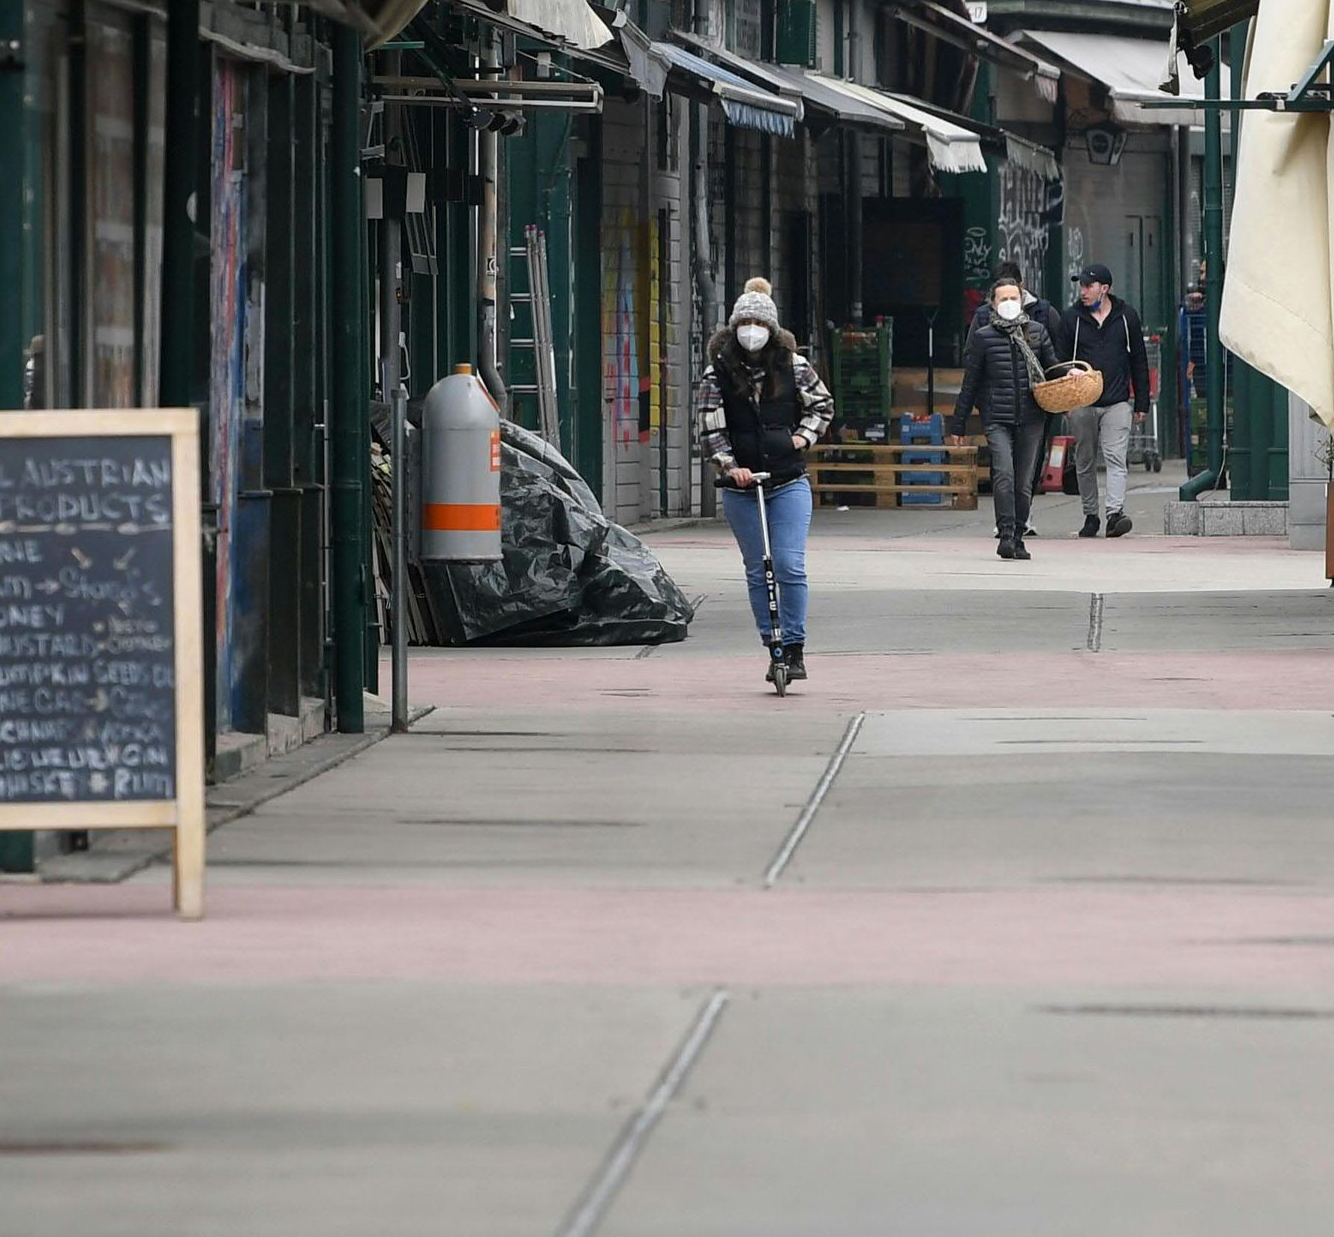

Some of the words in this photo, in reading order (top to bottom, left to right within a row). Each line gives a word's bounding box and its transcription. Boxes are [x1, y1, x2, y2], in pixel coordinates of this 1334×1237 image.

[18, 456, 170, 489] AUSTRIAN
[121, 743, 167, 768] GIN
[114, 767, 173, 800] RUM
